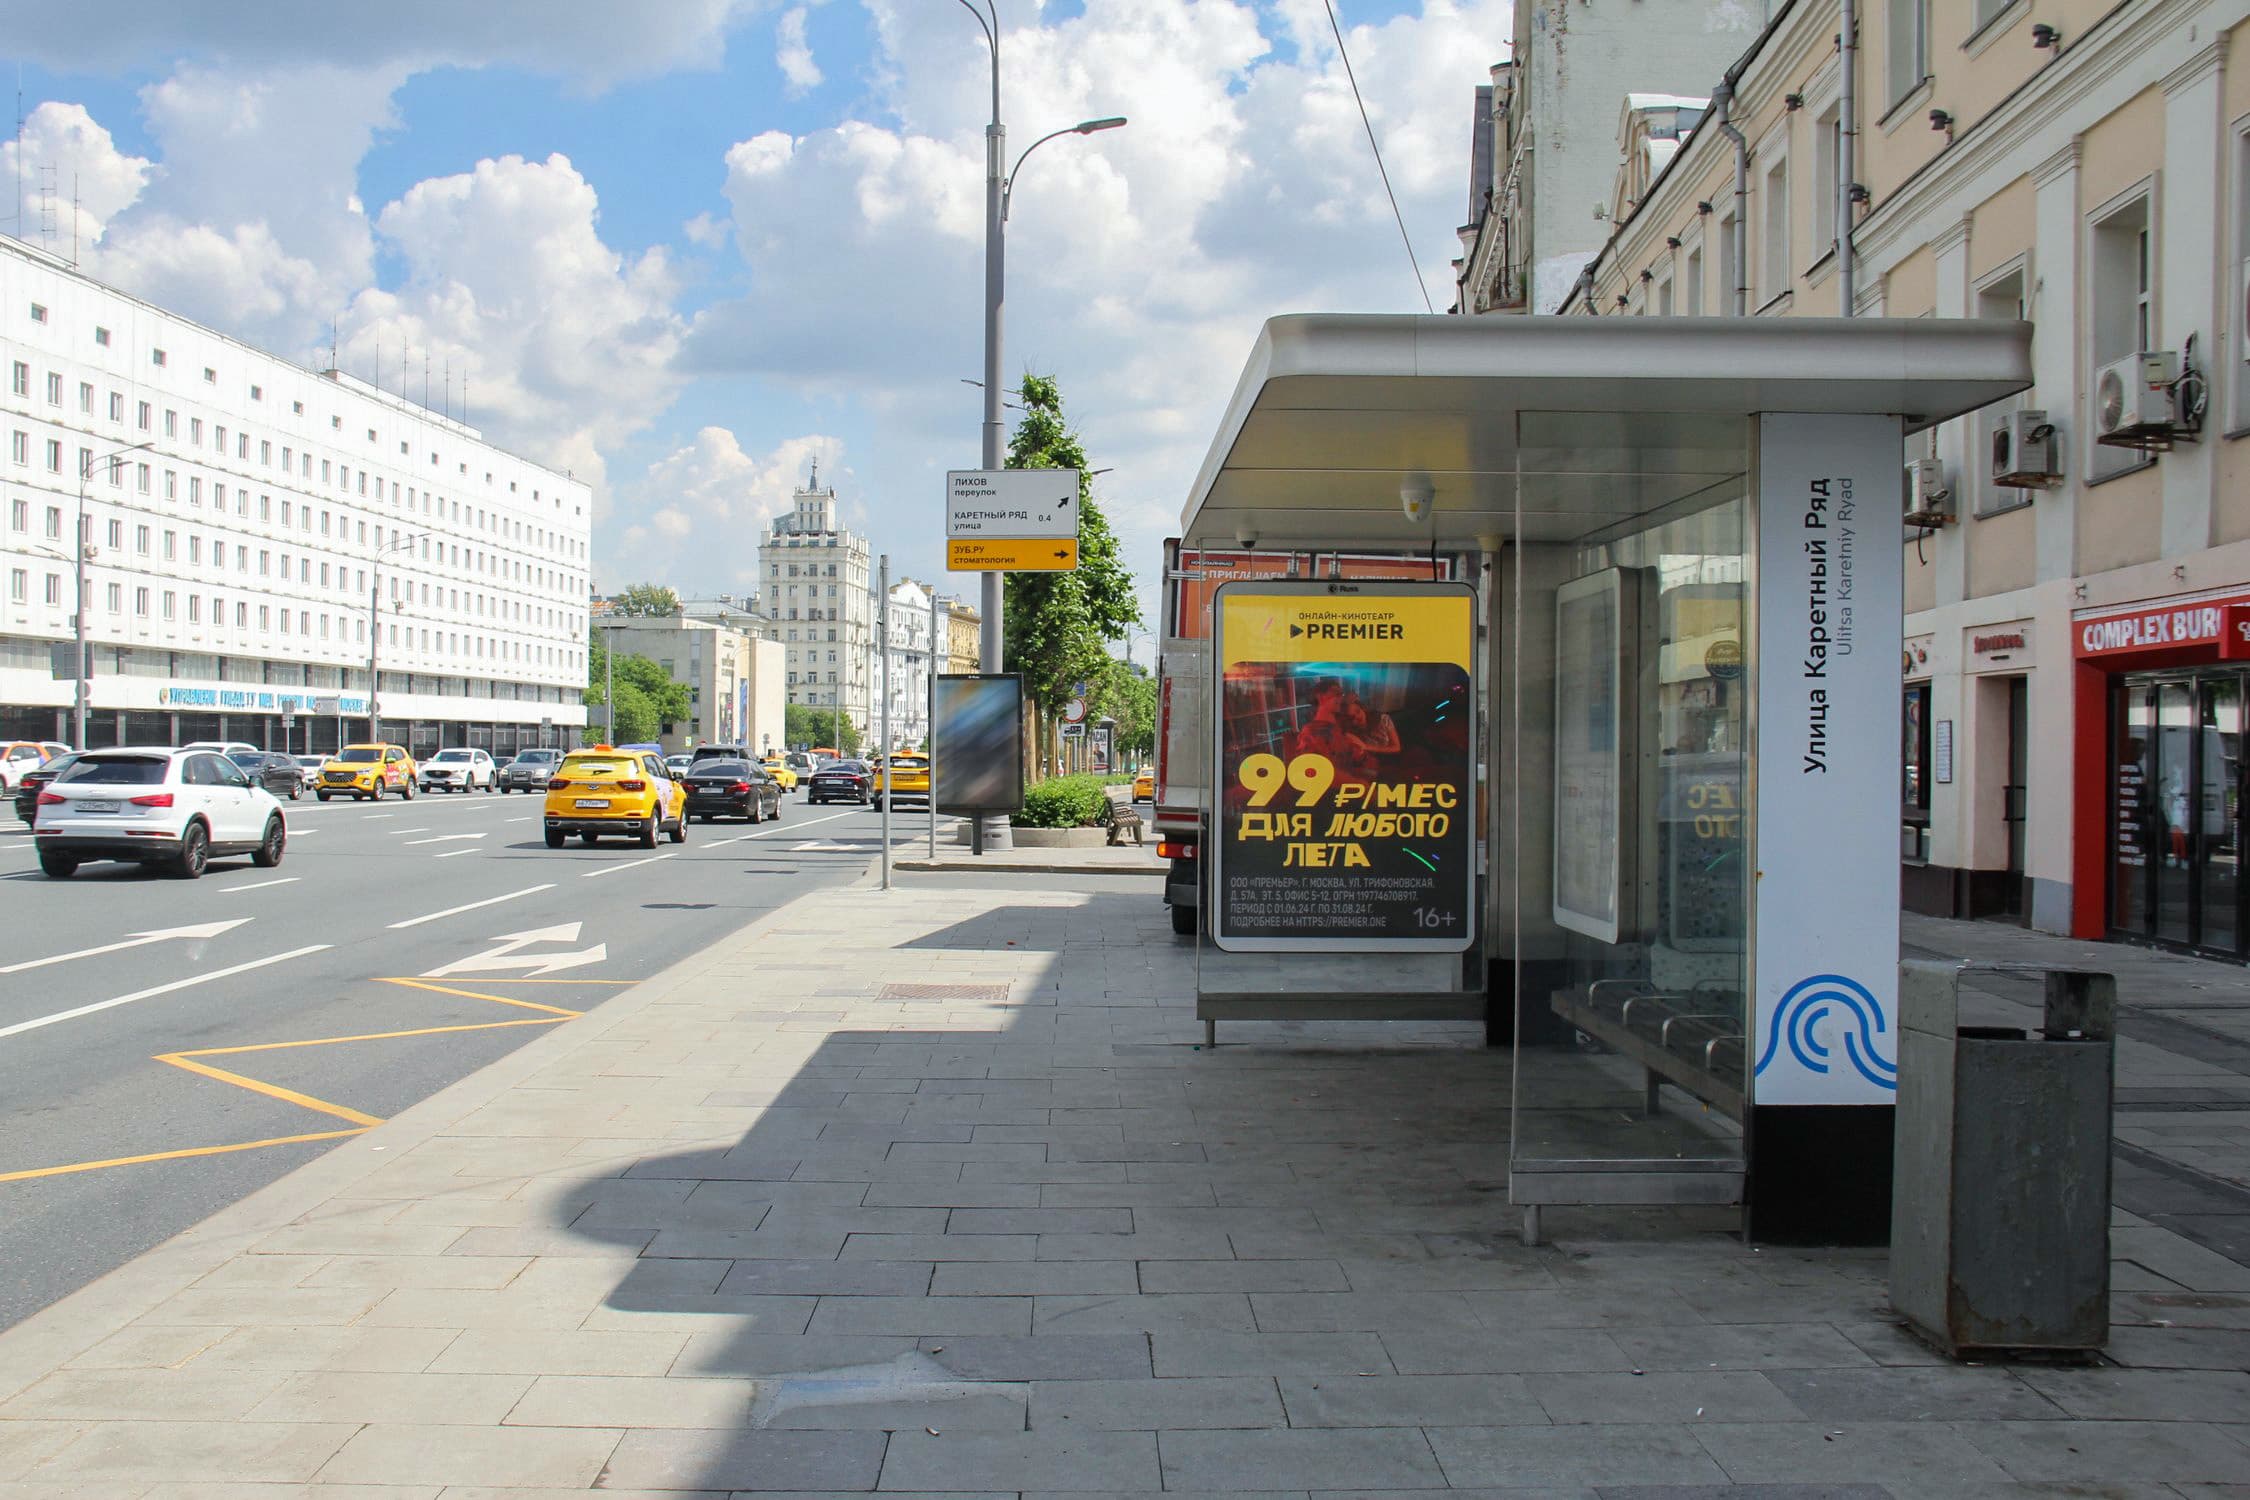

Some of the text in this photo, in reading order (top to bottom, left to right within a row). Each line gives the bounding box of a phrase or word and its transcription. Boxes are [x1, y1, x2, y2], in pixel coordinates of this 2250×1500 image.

[955, 478, 988, 487] ЛИХОВ
[954, 488, 997, 498] переулок
[954, 510, 1028, 520] КАРЕТНЫЙ РЯД
[1038, 514, 1051, 522] 0.4
[954, 522, 982, 531] улица
[954, 545, 985, 554] ЗУБ.РУ
[953, 557, 1016, 565] стоматология
[1836, 478, 1856, 656] Ulitsa Karetniy Ryad
[1298, 611, 1395, 620] ОНЛАЙН-КИНОТЕАТР
[1803, 478, 1832, 774] Улица Каретный Ряд
[1306, 624, 1403, 640] PREMIER
[2082, 613, 2170, 652] COMPLEX
[1238, 753, 1335, 807] 99
[1238, 813, 1450, 841] ДЛЯ ЛЮБОГО
[1282, 843, 1371, 867] ЛЕТА
[1230, 877, 1248, 888] ООО
[1284, 891, 1310, 901] ОФИС
[1333, 891, 1355, 901] ОГРН
[1230, 904, 1265, 914] ПЕРИОД
[1266, 904, 1273, 914] С
[1274, 904, 1309, 914] 01.06.24
[1318, 904, 1330, 914] ПО
[1331, 904, 1366, 914] 31.08.24
[1230, 917, 1387, 927] ПОДРОБНЕЕ НА HTTPS://PREMIER.ONE
[1413, 907, 1457, 928] 16+
